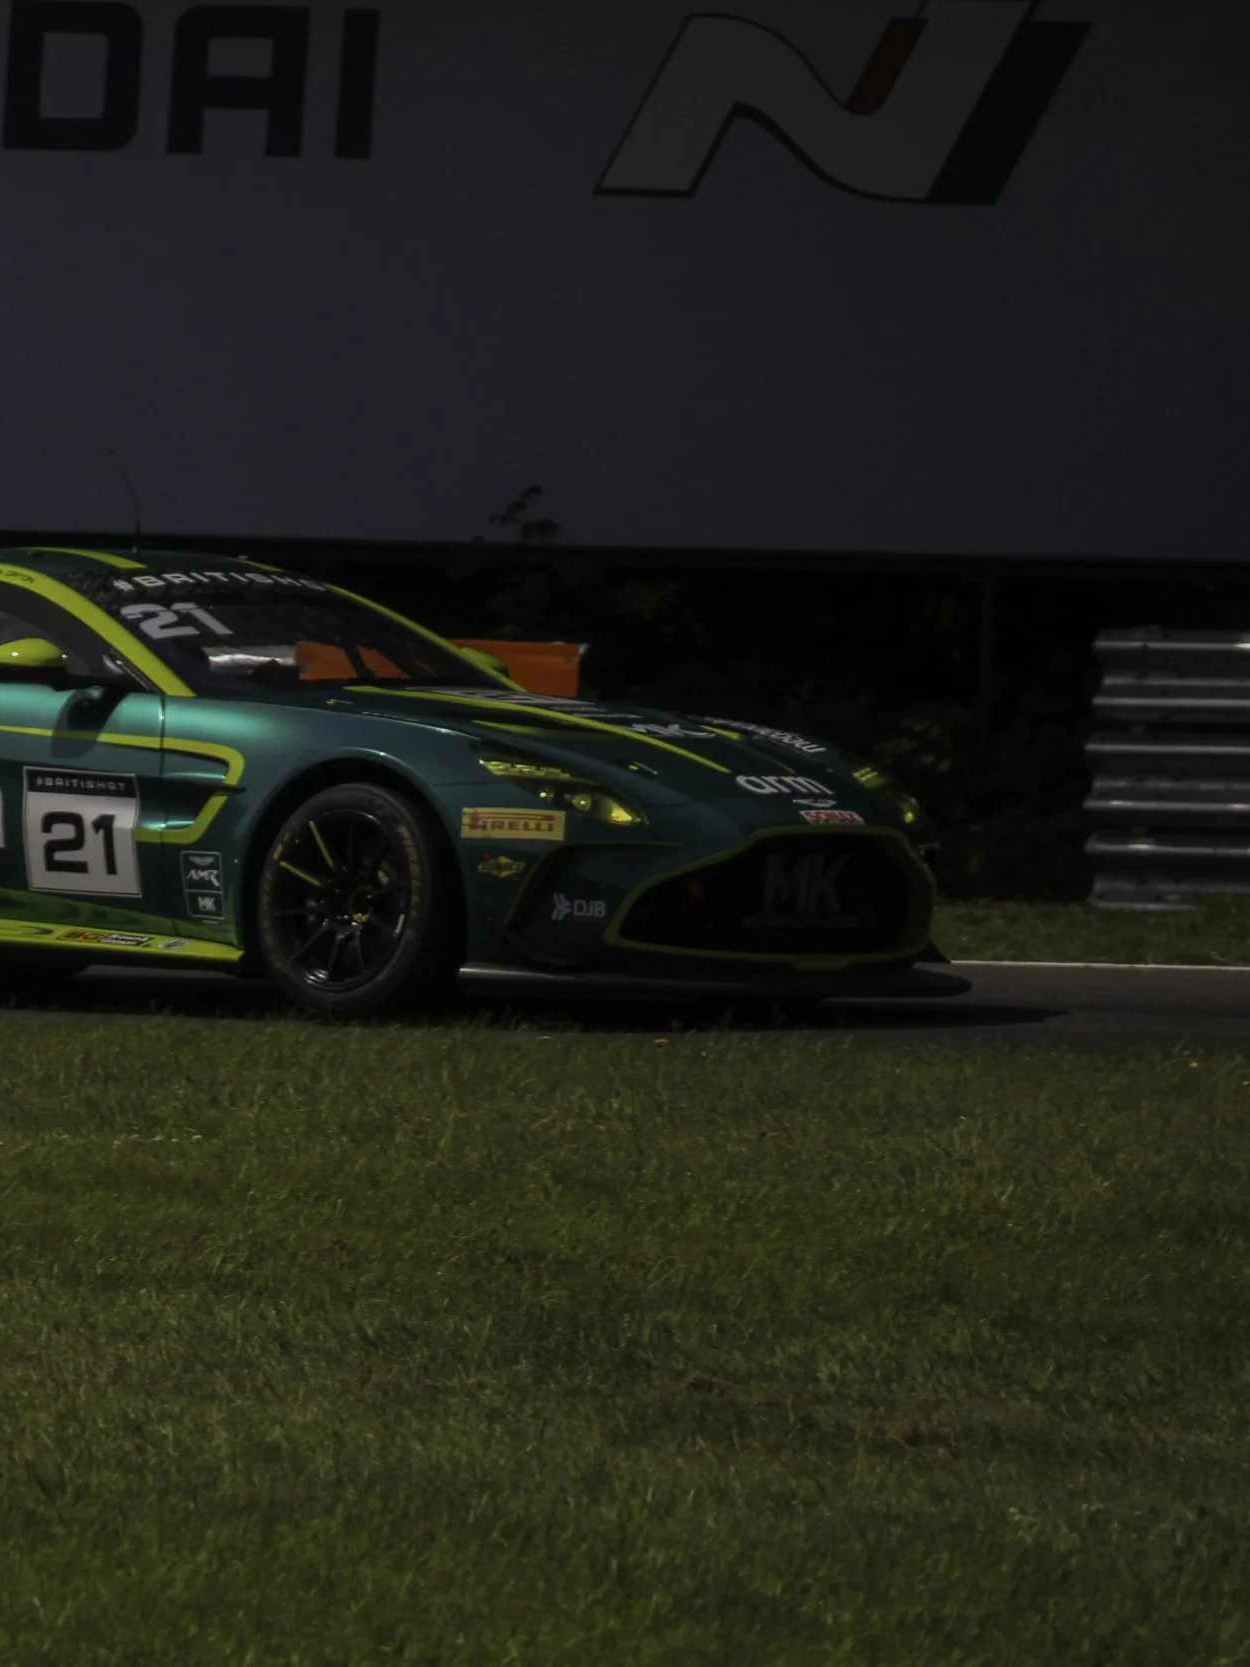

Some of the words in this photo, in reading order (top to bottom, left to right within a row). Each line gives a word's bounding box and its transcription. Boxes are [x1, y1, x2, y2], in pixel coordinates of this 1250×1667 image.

[119, 602, 234, 640] 21
[735, 774, 835, 796] arm
[468, 810, 556, 832] PIRELLI
[41, 811, 117, 875] 21
[186, 868, 221, 888] AMR
[763, 853, 851, 914] MK
[573, 899, 607, 917] DJB
